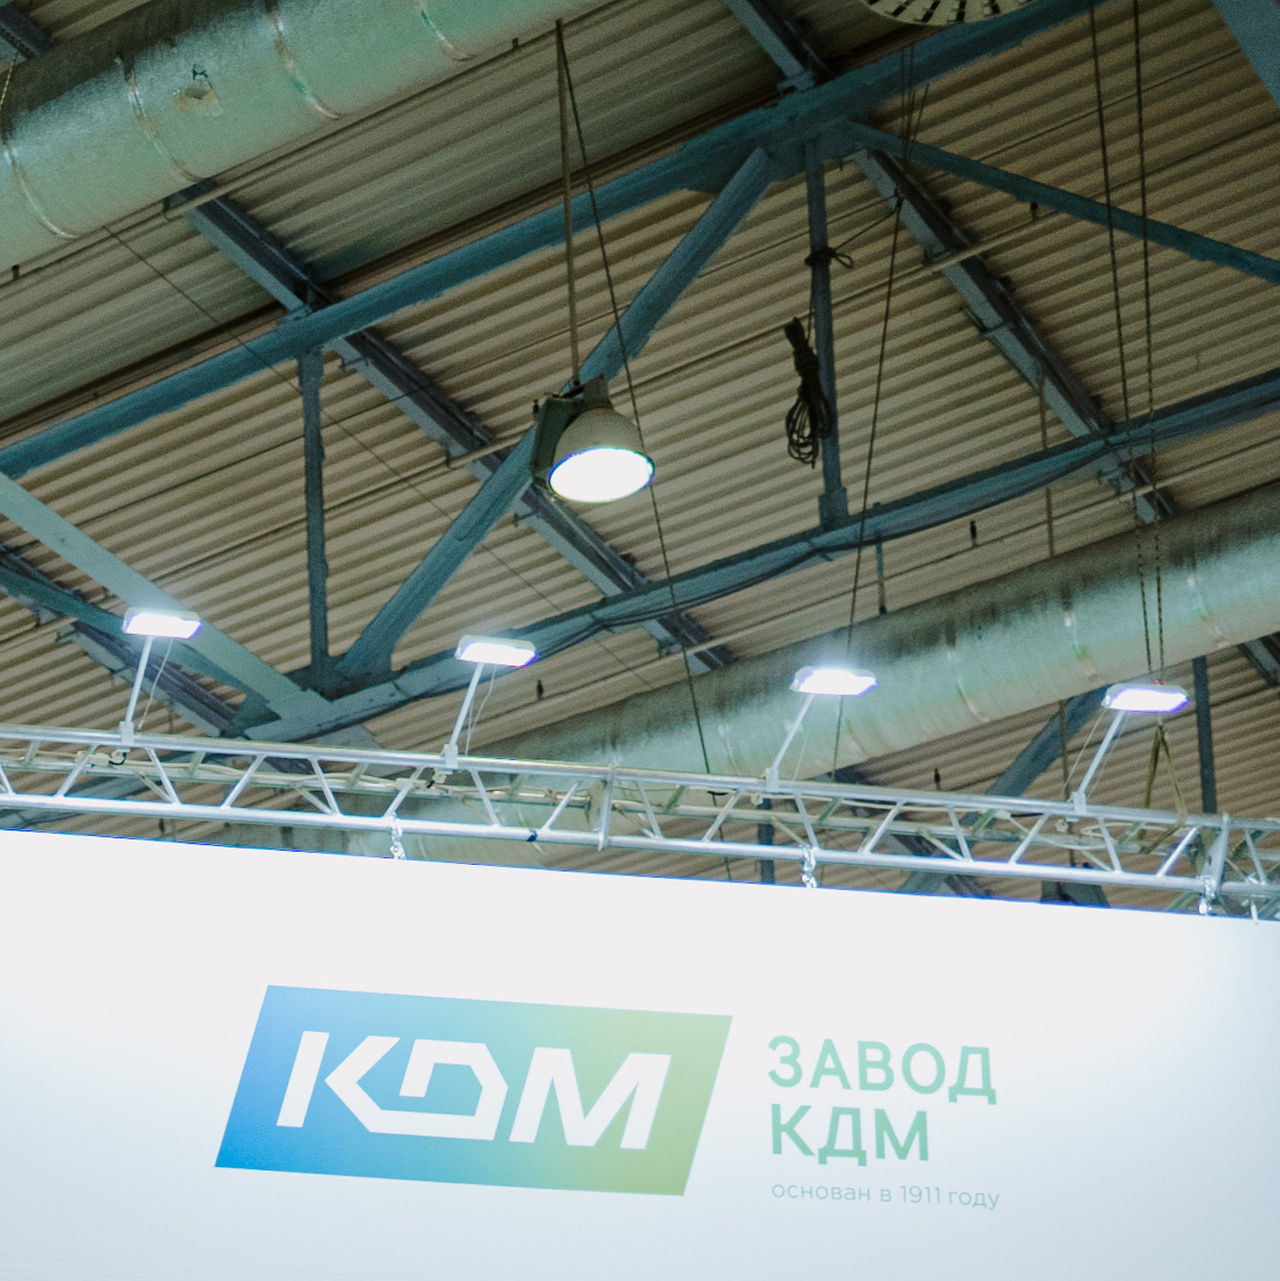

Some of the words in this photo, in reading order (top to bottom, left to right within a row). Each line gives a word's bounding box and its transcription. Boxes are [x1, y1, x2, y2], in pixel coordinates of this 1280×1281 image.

[768, 1035, 996, 1105] ЗАВОД
[771, 1103, 930, 1166] КДМ
[771, 1182, 873, 1202] основан
[879, 1187, 892, 1203] в
[898, 1184, 942, 1206] 1911
[948, 1188, 1001, 1210] году
